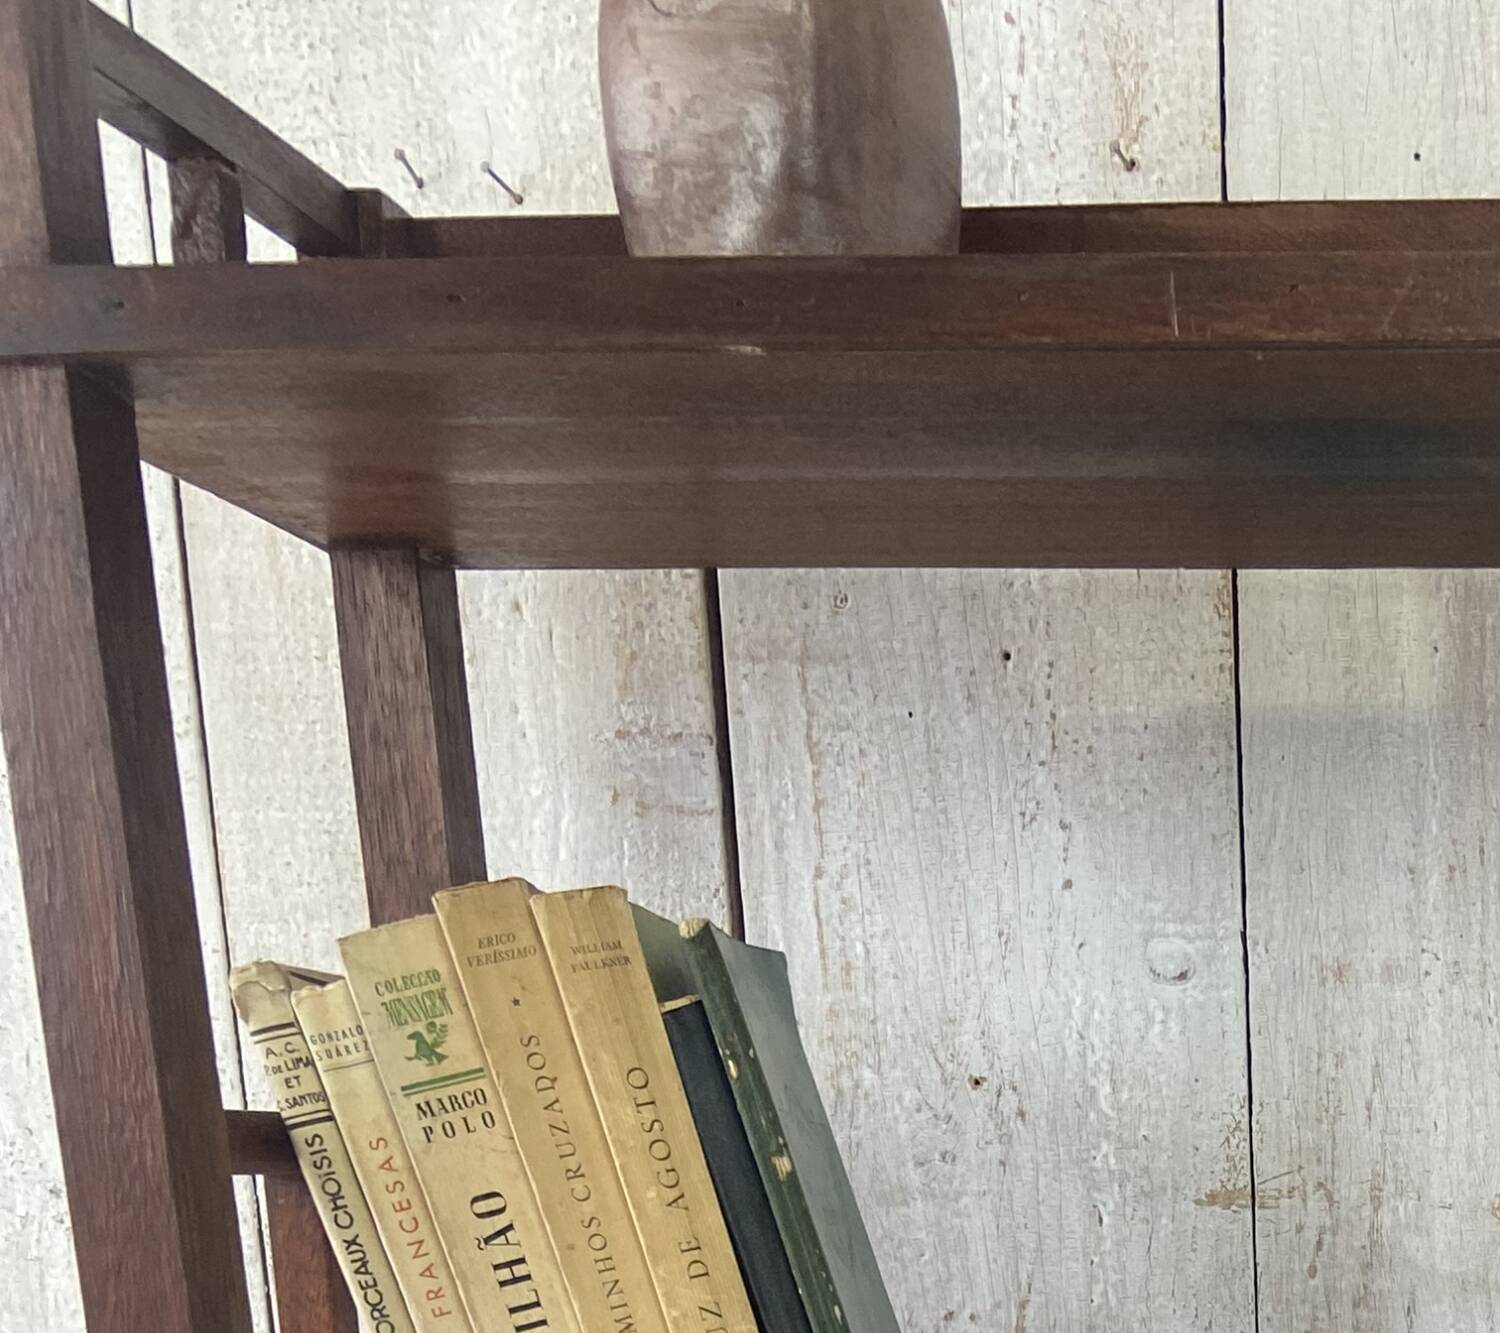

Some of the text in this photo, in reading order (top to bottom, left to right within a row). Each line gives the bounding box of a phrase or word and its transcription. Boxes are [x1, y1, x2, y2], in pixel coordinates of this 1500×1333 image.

[478, 932, 516, 949] ERICO
[569, 940, 623, 955] WILLIAM
[570, 956, 632, 973] FAULKNER
[310, 1025, 364, 1045] GONZALO
[285, 1075, 301, 1089] ET
[415, 1088, 488, 1121] MARCO
[520, 1034, 592, 1202] CRUZADOS
[422, 1110, 496, 1144] POLO
[626, 1066, 690, 1212] AGOSTO
[305, 1133, 354, 1229] CHOISIS
[369, 1137, 452, 1318] FRANCESAS
[677, 1236, 710, 1281] DE
